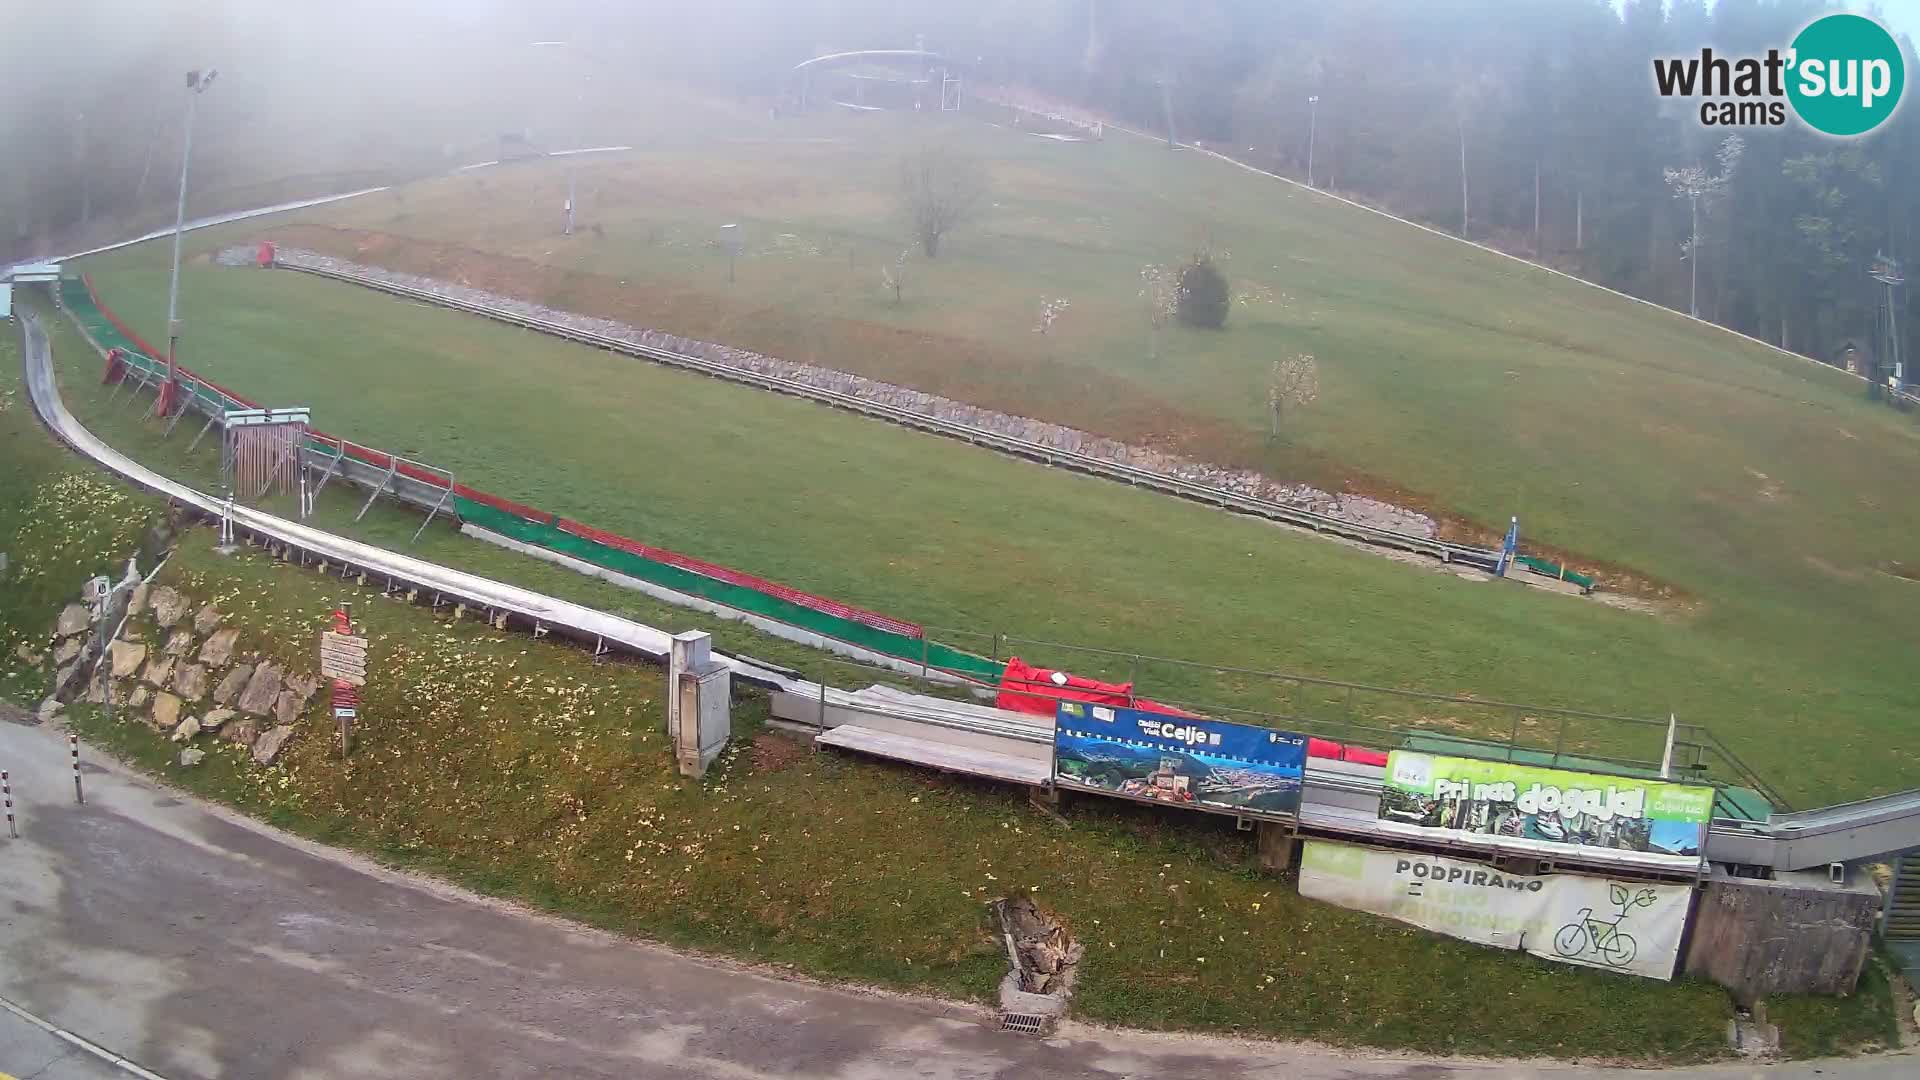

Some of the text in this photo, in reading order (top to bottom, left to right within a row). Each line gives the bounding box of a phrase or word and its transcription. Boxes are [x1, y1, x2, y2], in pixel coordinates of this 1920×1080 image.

[1161, 723, 1207, 746] Celje
[1473, 781, 1517, 802] nas
[1396, 859, 1544, 893] PODPIRAMO
